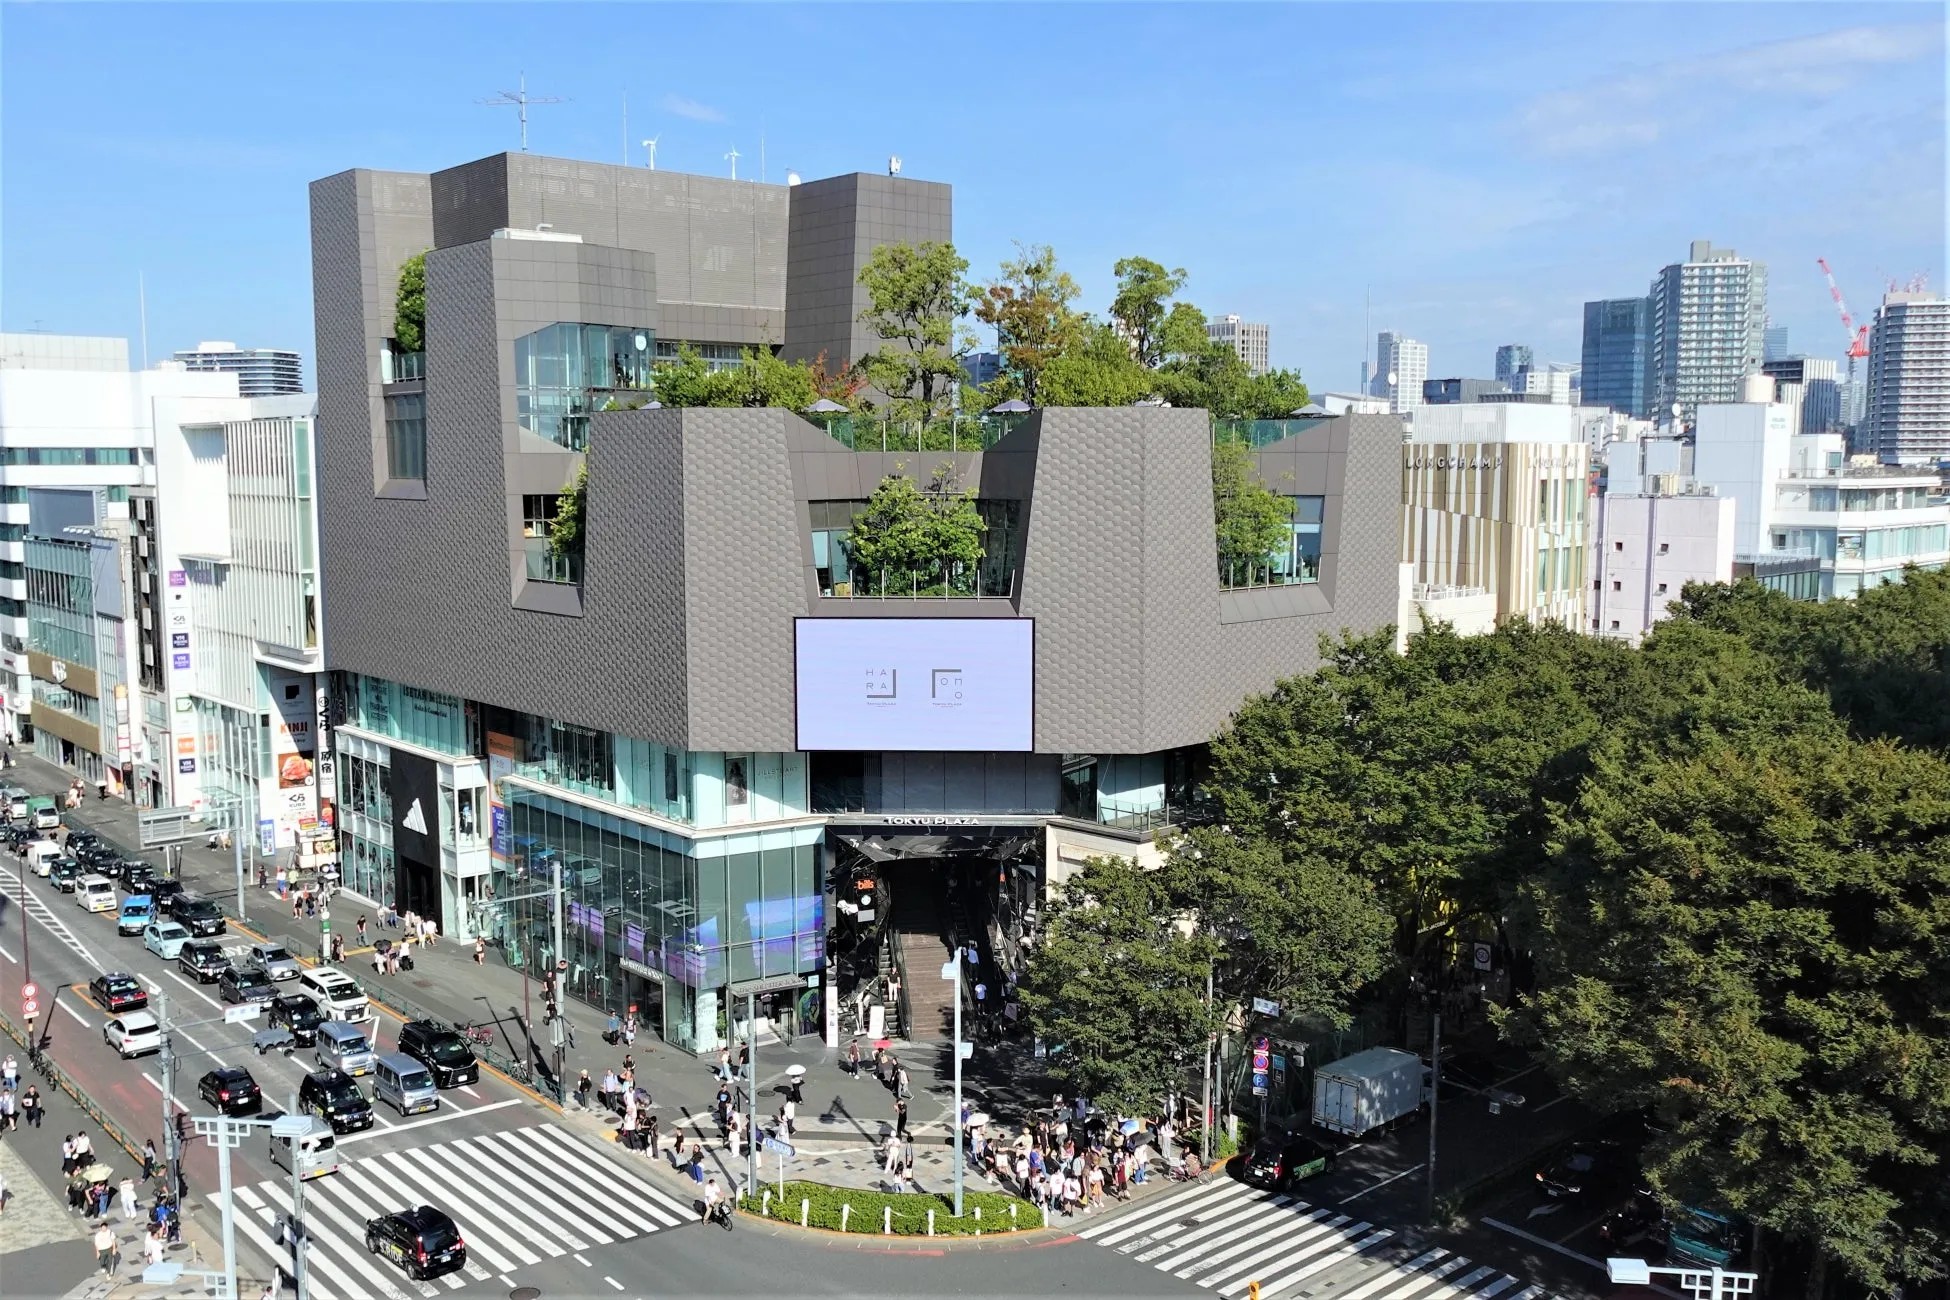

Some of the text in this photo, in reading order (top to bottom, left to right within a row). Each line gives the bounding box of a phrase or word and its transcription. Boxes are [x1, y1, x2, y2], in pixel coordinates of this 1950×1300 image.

[1405, 456, 1503, 470] LONGCHAMP
[280, 721, 308, 734] KINJI
[320, 750, 332, 773] 原宿
[289, 793, 305, 803] くら
[886, 816, 980, 825] TOKYU PLAZA
